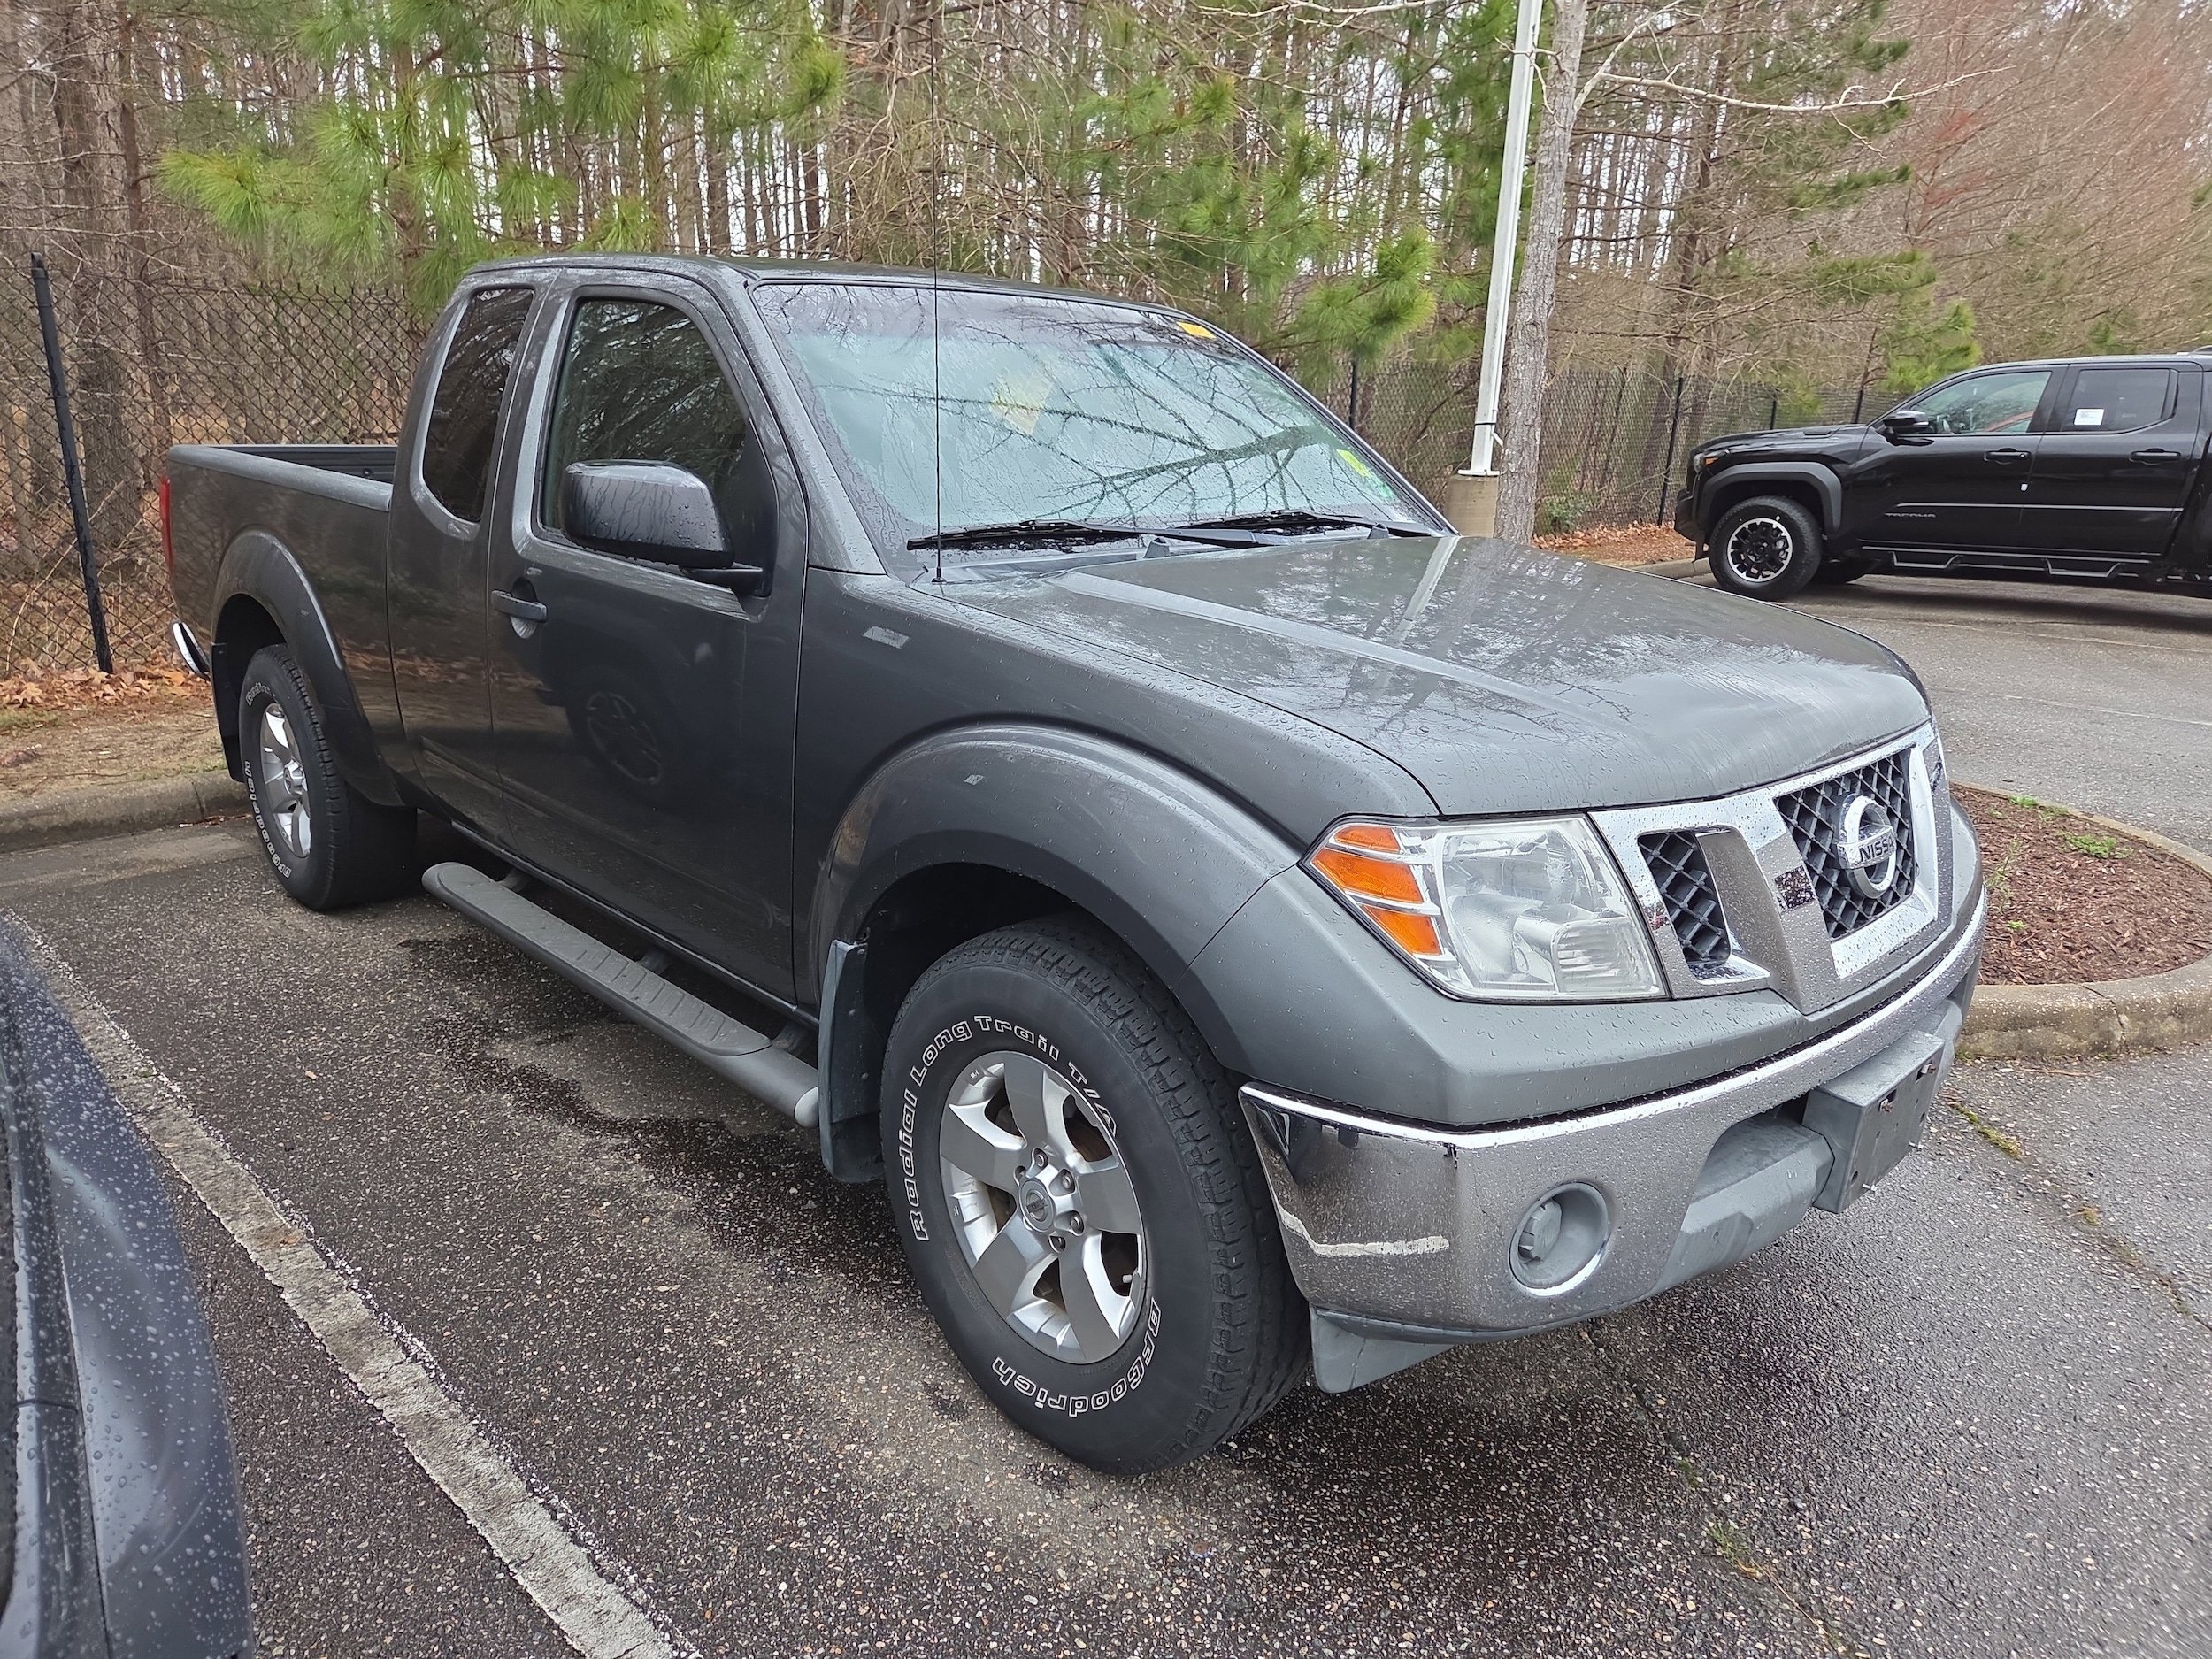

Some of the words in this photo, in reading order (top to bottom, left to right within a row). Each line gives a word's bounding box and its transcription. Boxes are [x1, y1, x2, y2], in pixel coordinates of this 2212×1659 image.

[1859, 835, 1895, 862] NISSA
[910, 1021, 972, 1087] Long
[974, 1016, 1059, 1061] Trail
[899, 1088, 929, 1240] Radial
[992, 1297, 1161, 1417] BFGoodrich
